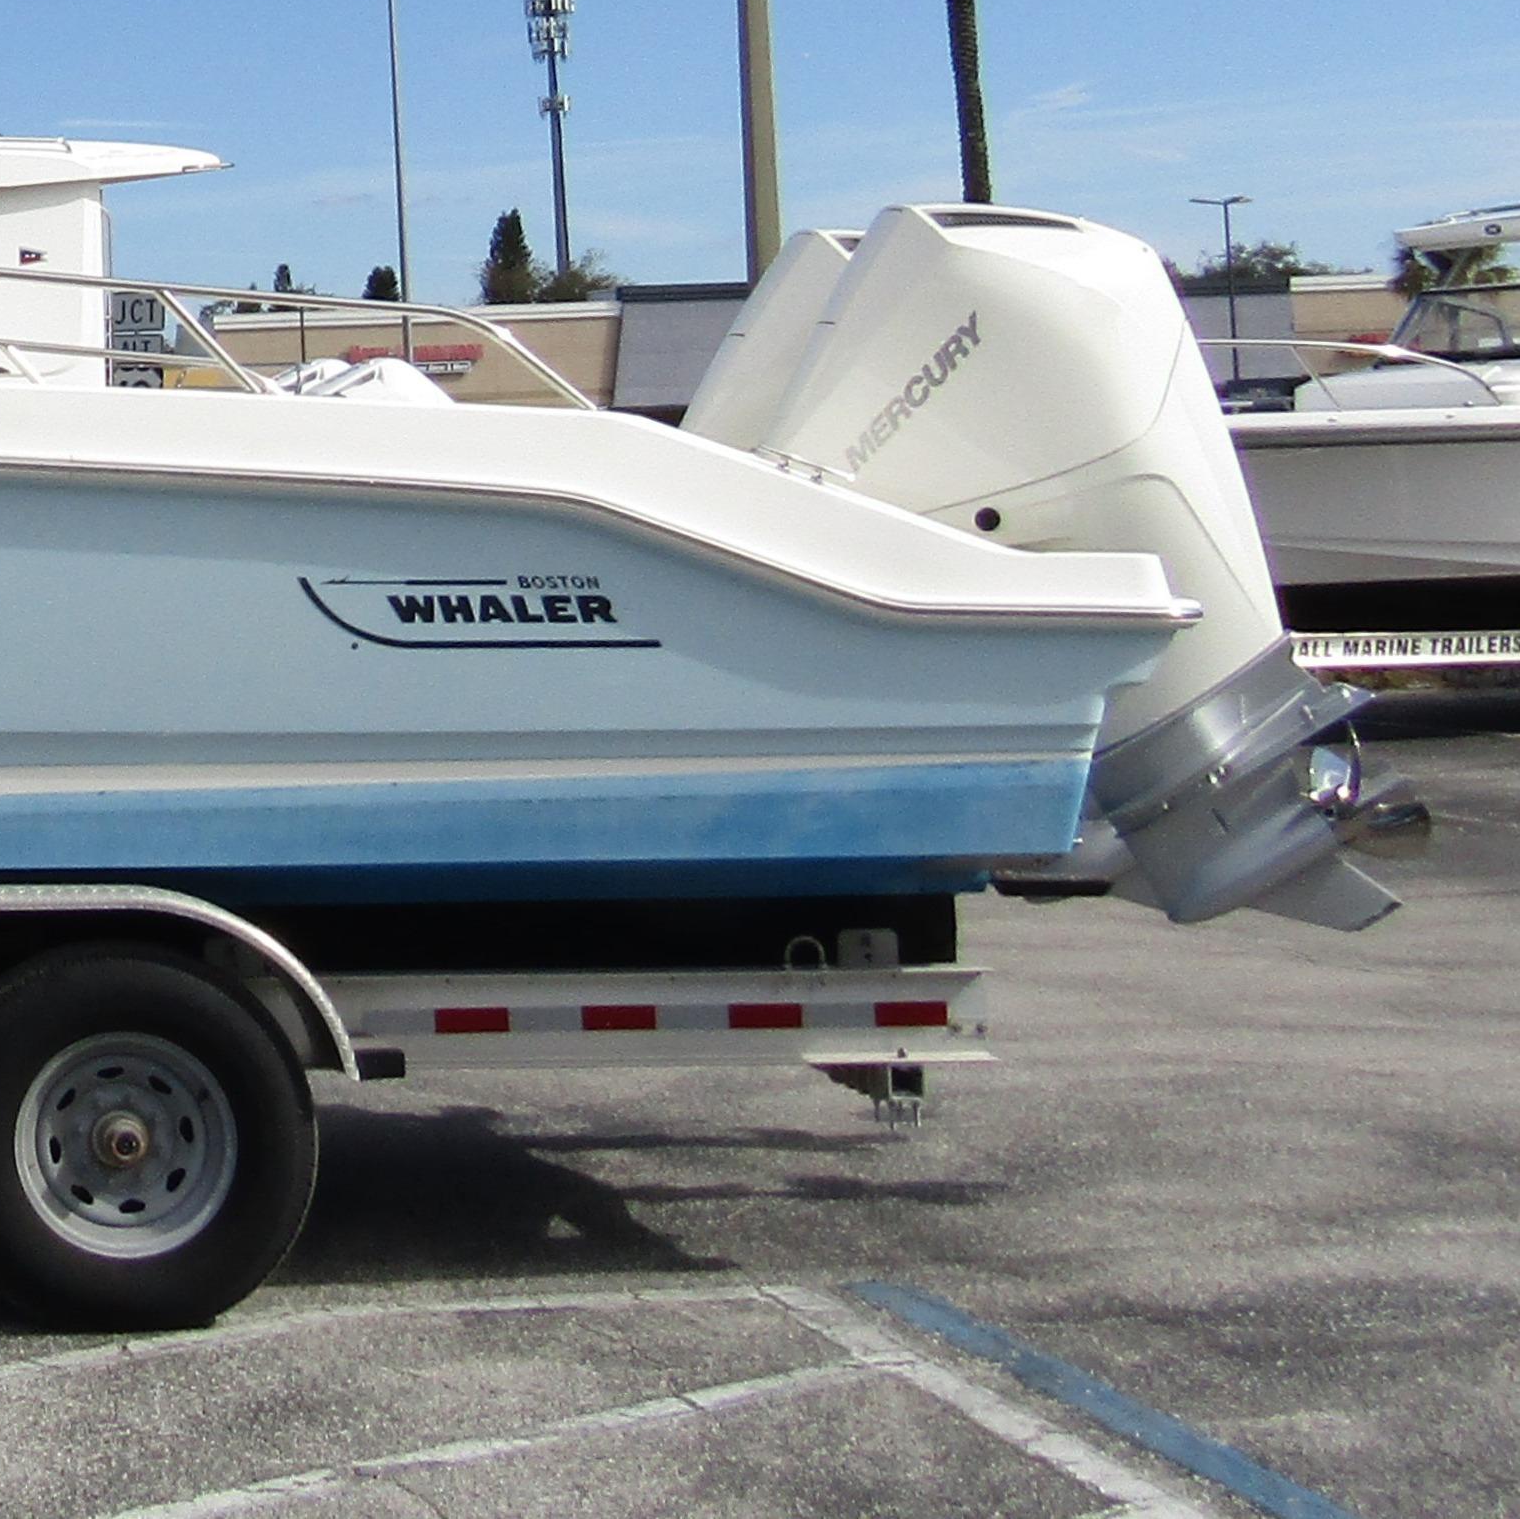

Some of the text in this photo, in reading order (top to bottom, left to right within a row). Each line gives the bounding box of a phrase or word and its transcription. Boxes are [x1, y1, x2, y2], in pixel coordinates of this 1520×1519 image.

[115, 299, 158, 325] JCT
[846, 310, 981, 472] MERCURY
[517, 575, 601, 590] BOSTON
[387, 595, 618, 624] WHALER
[1298, 641, 1331, 658] ALL
[1342, 638, 1422, 657] MARINE
